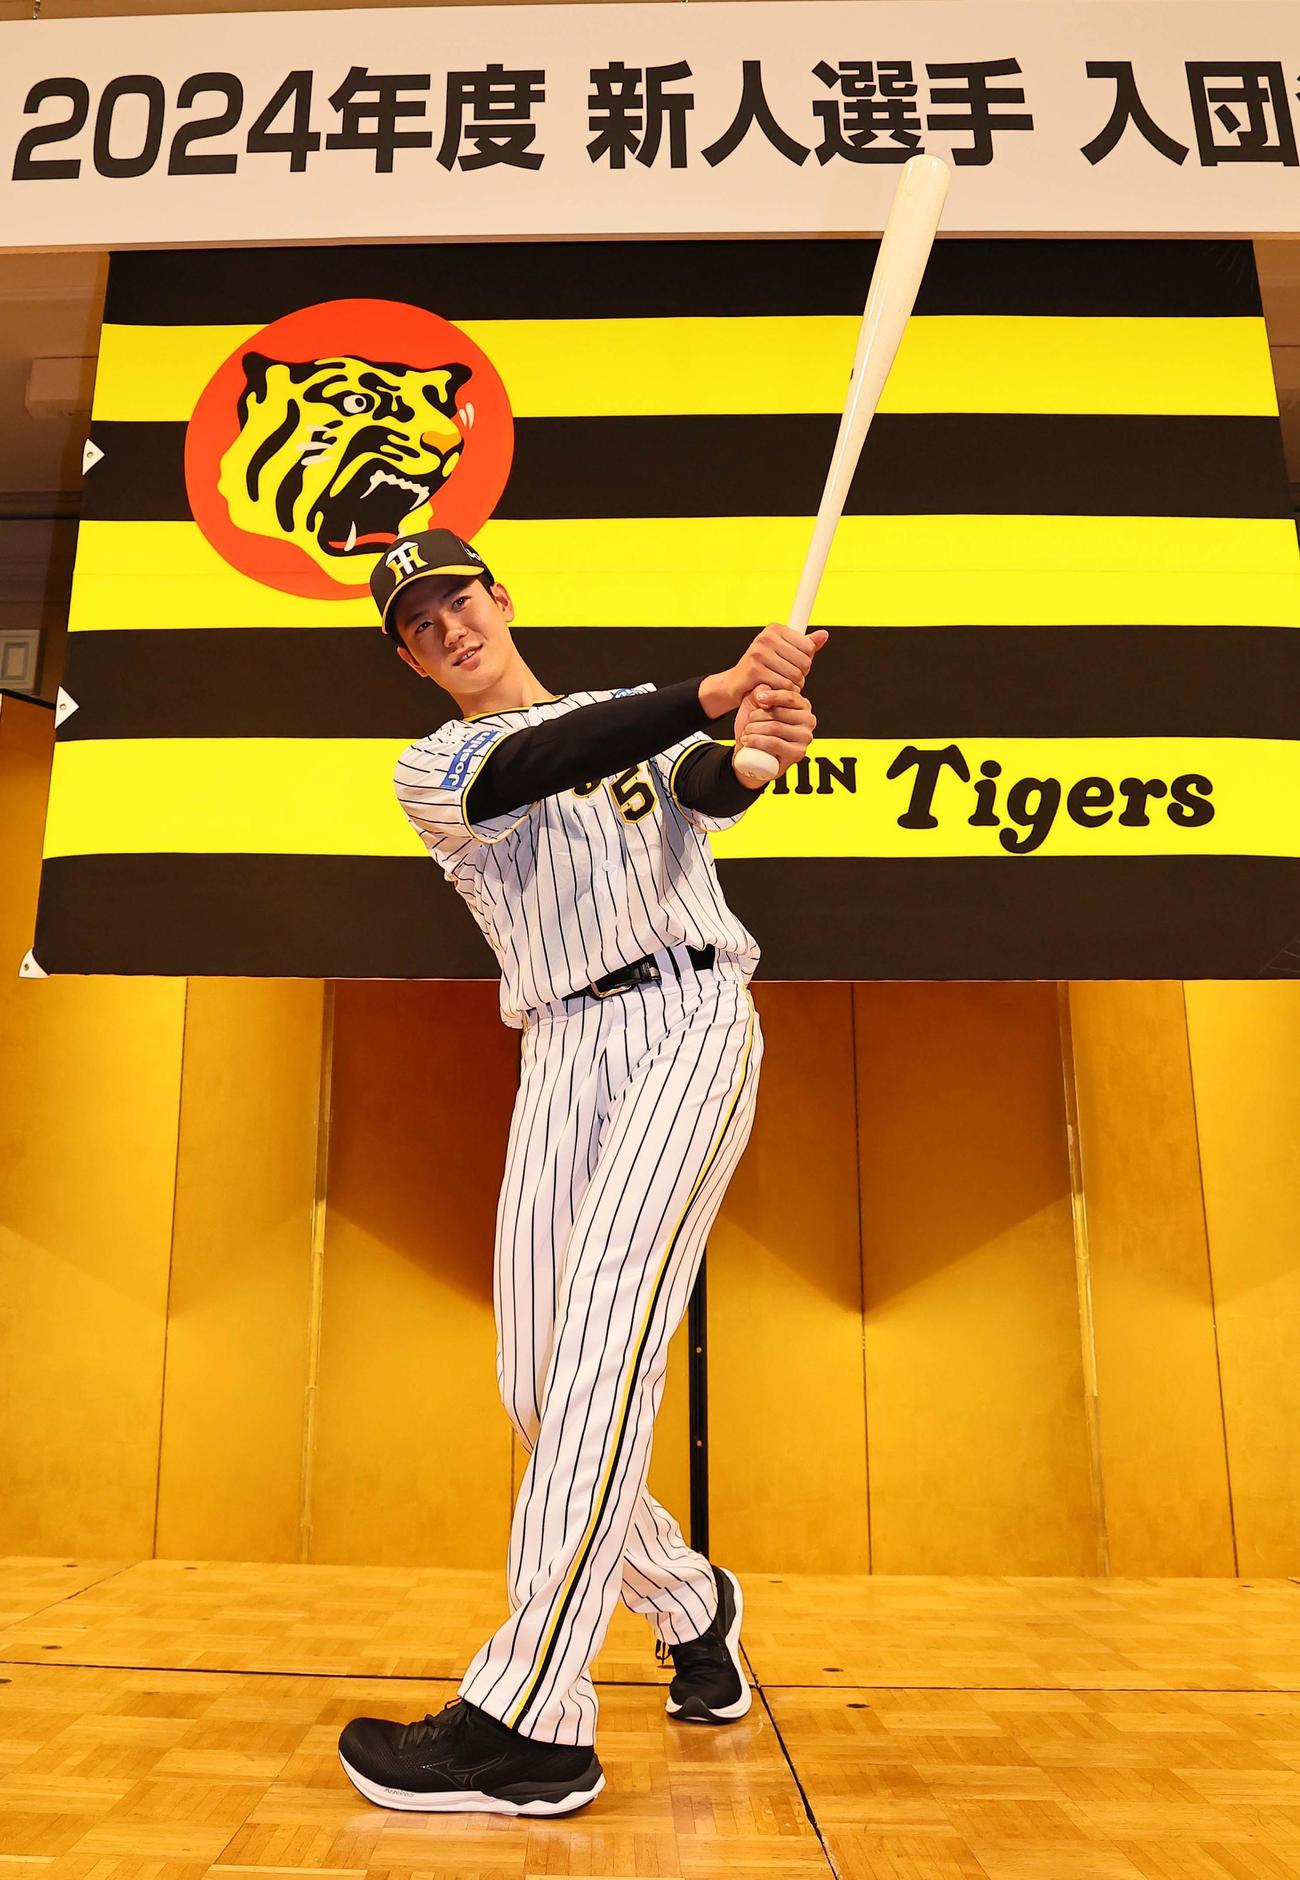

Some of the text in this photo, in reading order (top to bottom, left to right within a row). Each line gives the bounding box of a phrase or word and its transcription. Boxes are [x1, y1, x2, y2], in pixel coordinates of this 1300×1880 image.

[12, 58, 1300, 180] 2024年度 新人選手 入団
[447, 731, 491, 786] Joshin
[887, 745, 1215, 854] Tigers
